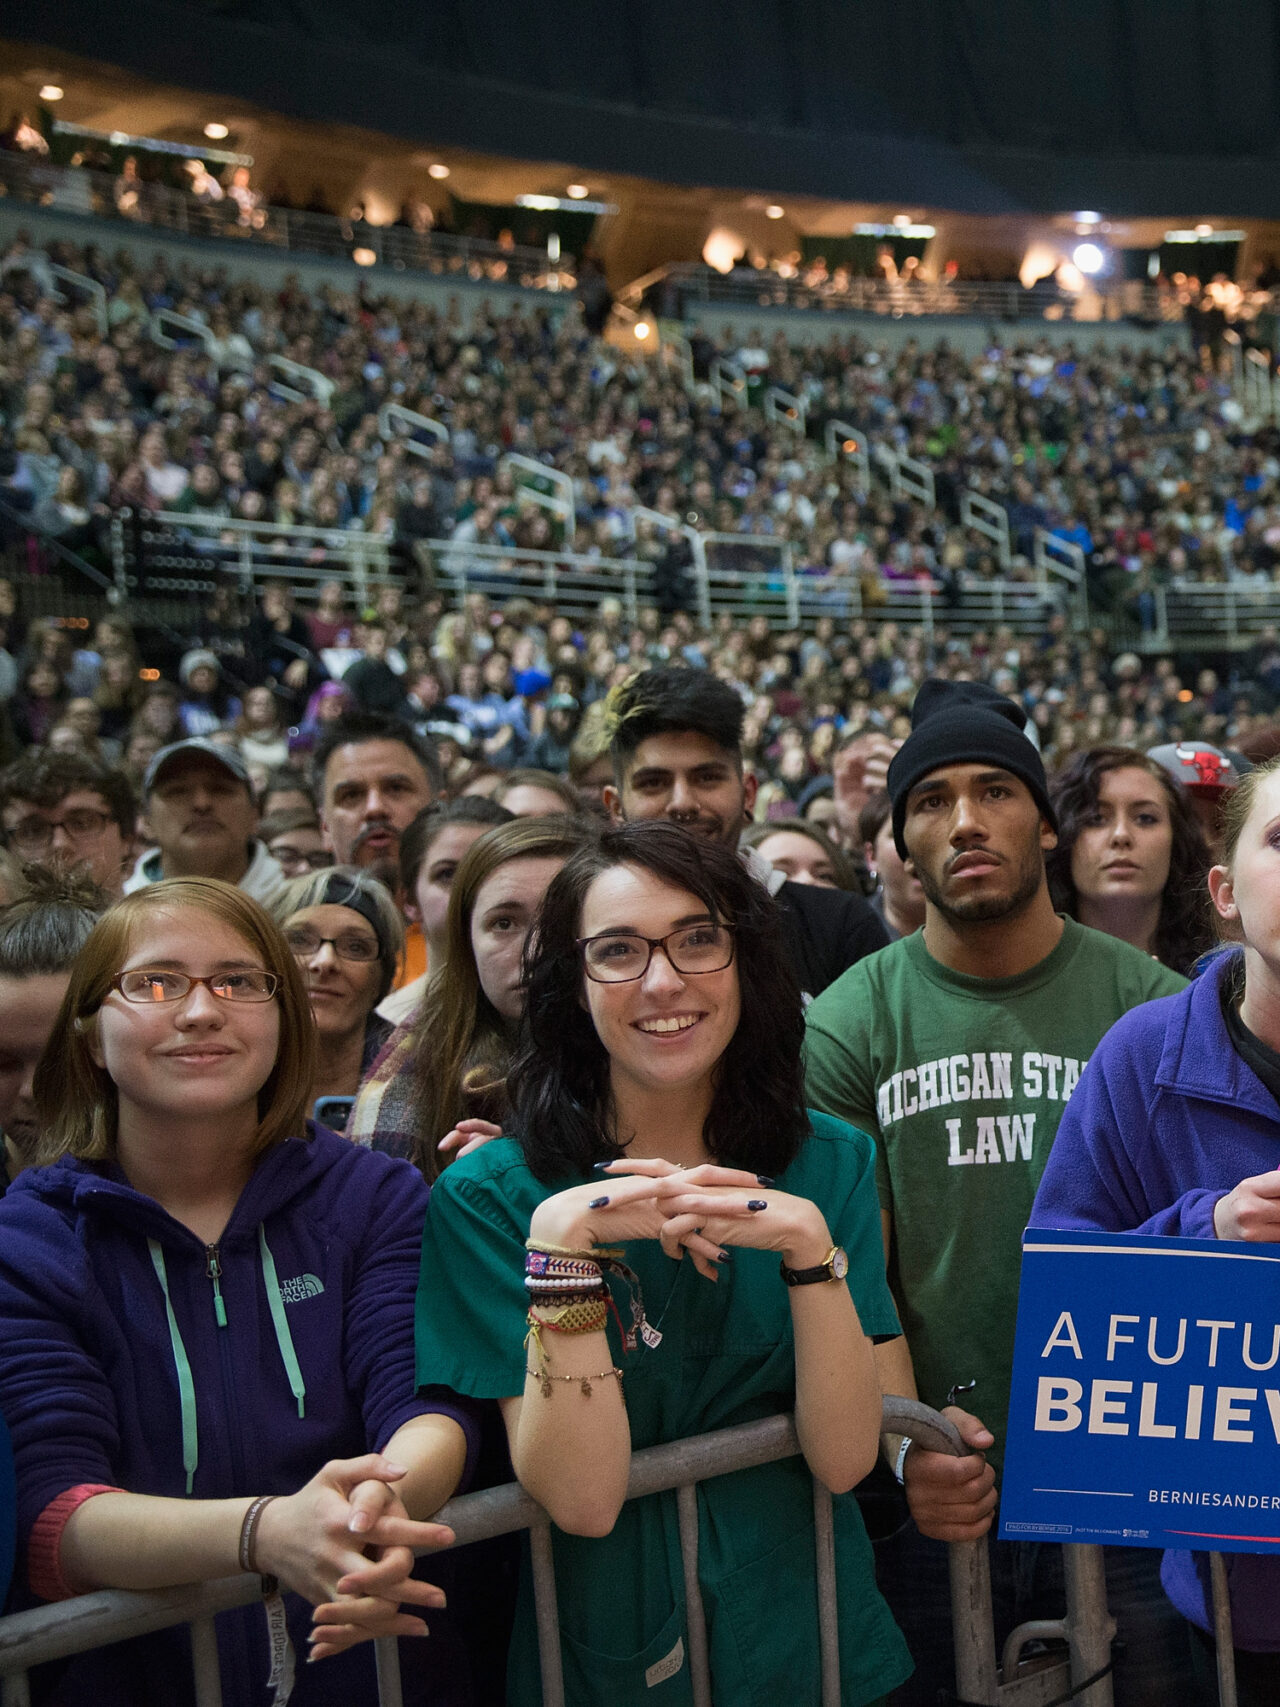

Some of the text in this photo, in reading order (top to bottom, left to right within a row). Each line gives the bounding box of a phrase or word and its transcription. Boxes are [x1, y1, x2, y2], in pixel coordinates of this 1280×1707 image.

[877, 1052, 1088, 1127] MICHIGAN STA
[945, 1113, 1036, 1166] LAW
[279, 1283, 306, 1296] ORTH
[282, 1276, 303, 1288] THE
[1041, 1311, 1083, 1359] A
